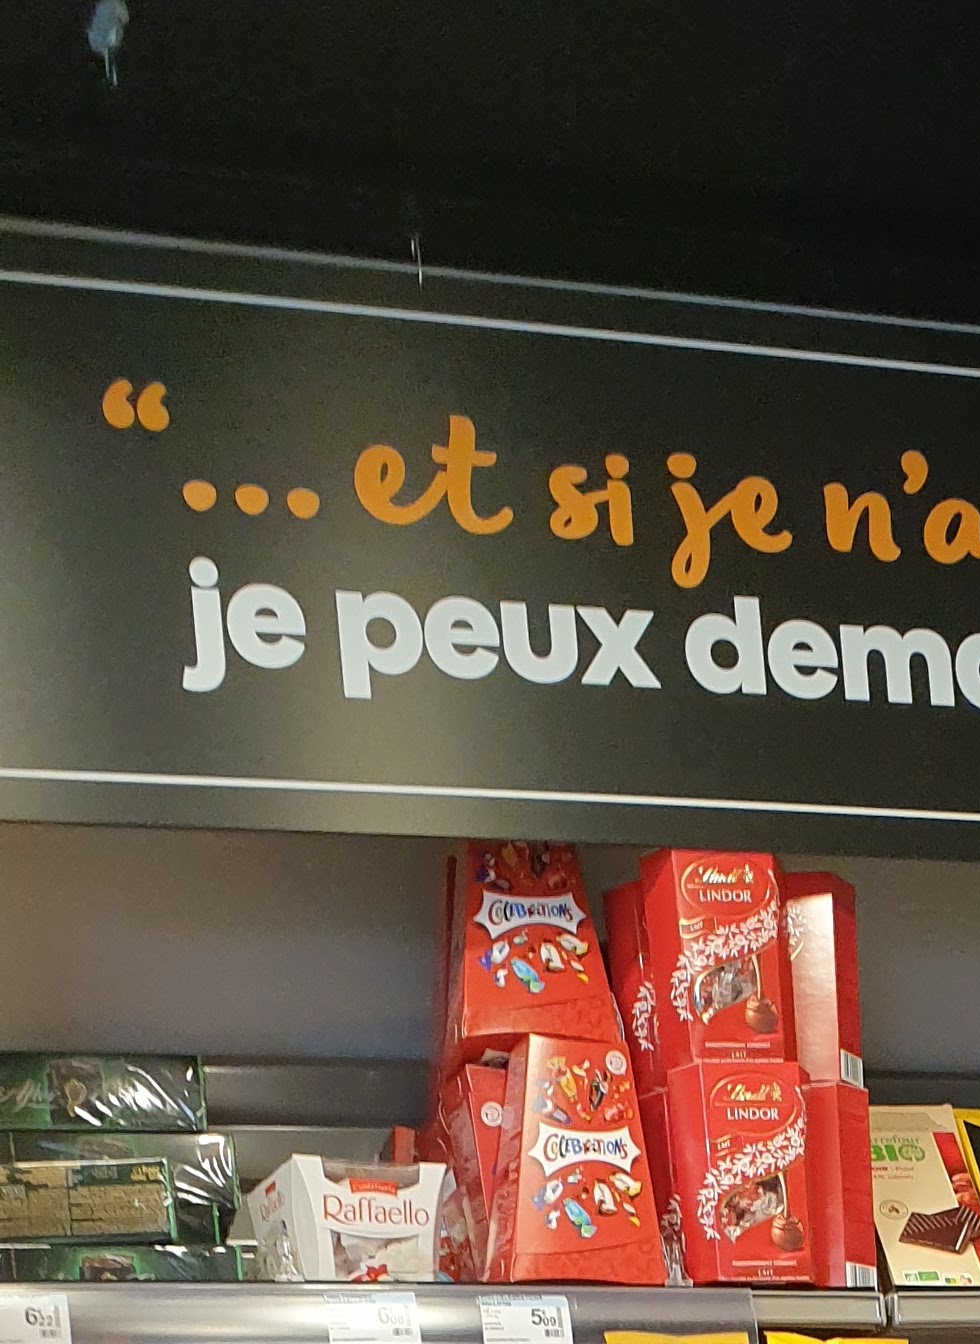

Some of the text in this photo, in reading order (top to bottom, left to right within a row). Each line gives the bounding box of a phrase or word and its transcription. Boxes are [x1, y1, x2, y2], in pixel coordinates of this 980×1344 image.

[354, 415, 513, 534] et
[549, 454, 634, 546] si
[668, 452, 793, 588] je
[182, 556, 306, 692] je
[334, 590, 661, 700] peux
[699, 888, 752, 903] LINDOR
[727, 1107, 779, 1121] LINDOR
[323, 1194, 429, 1227] Raffaello
